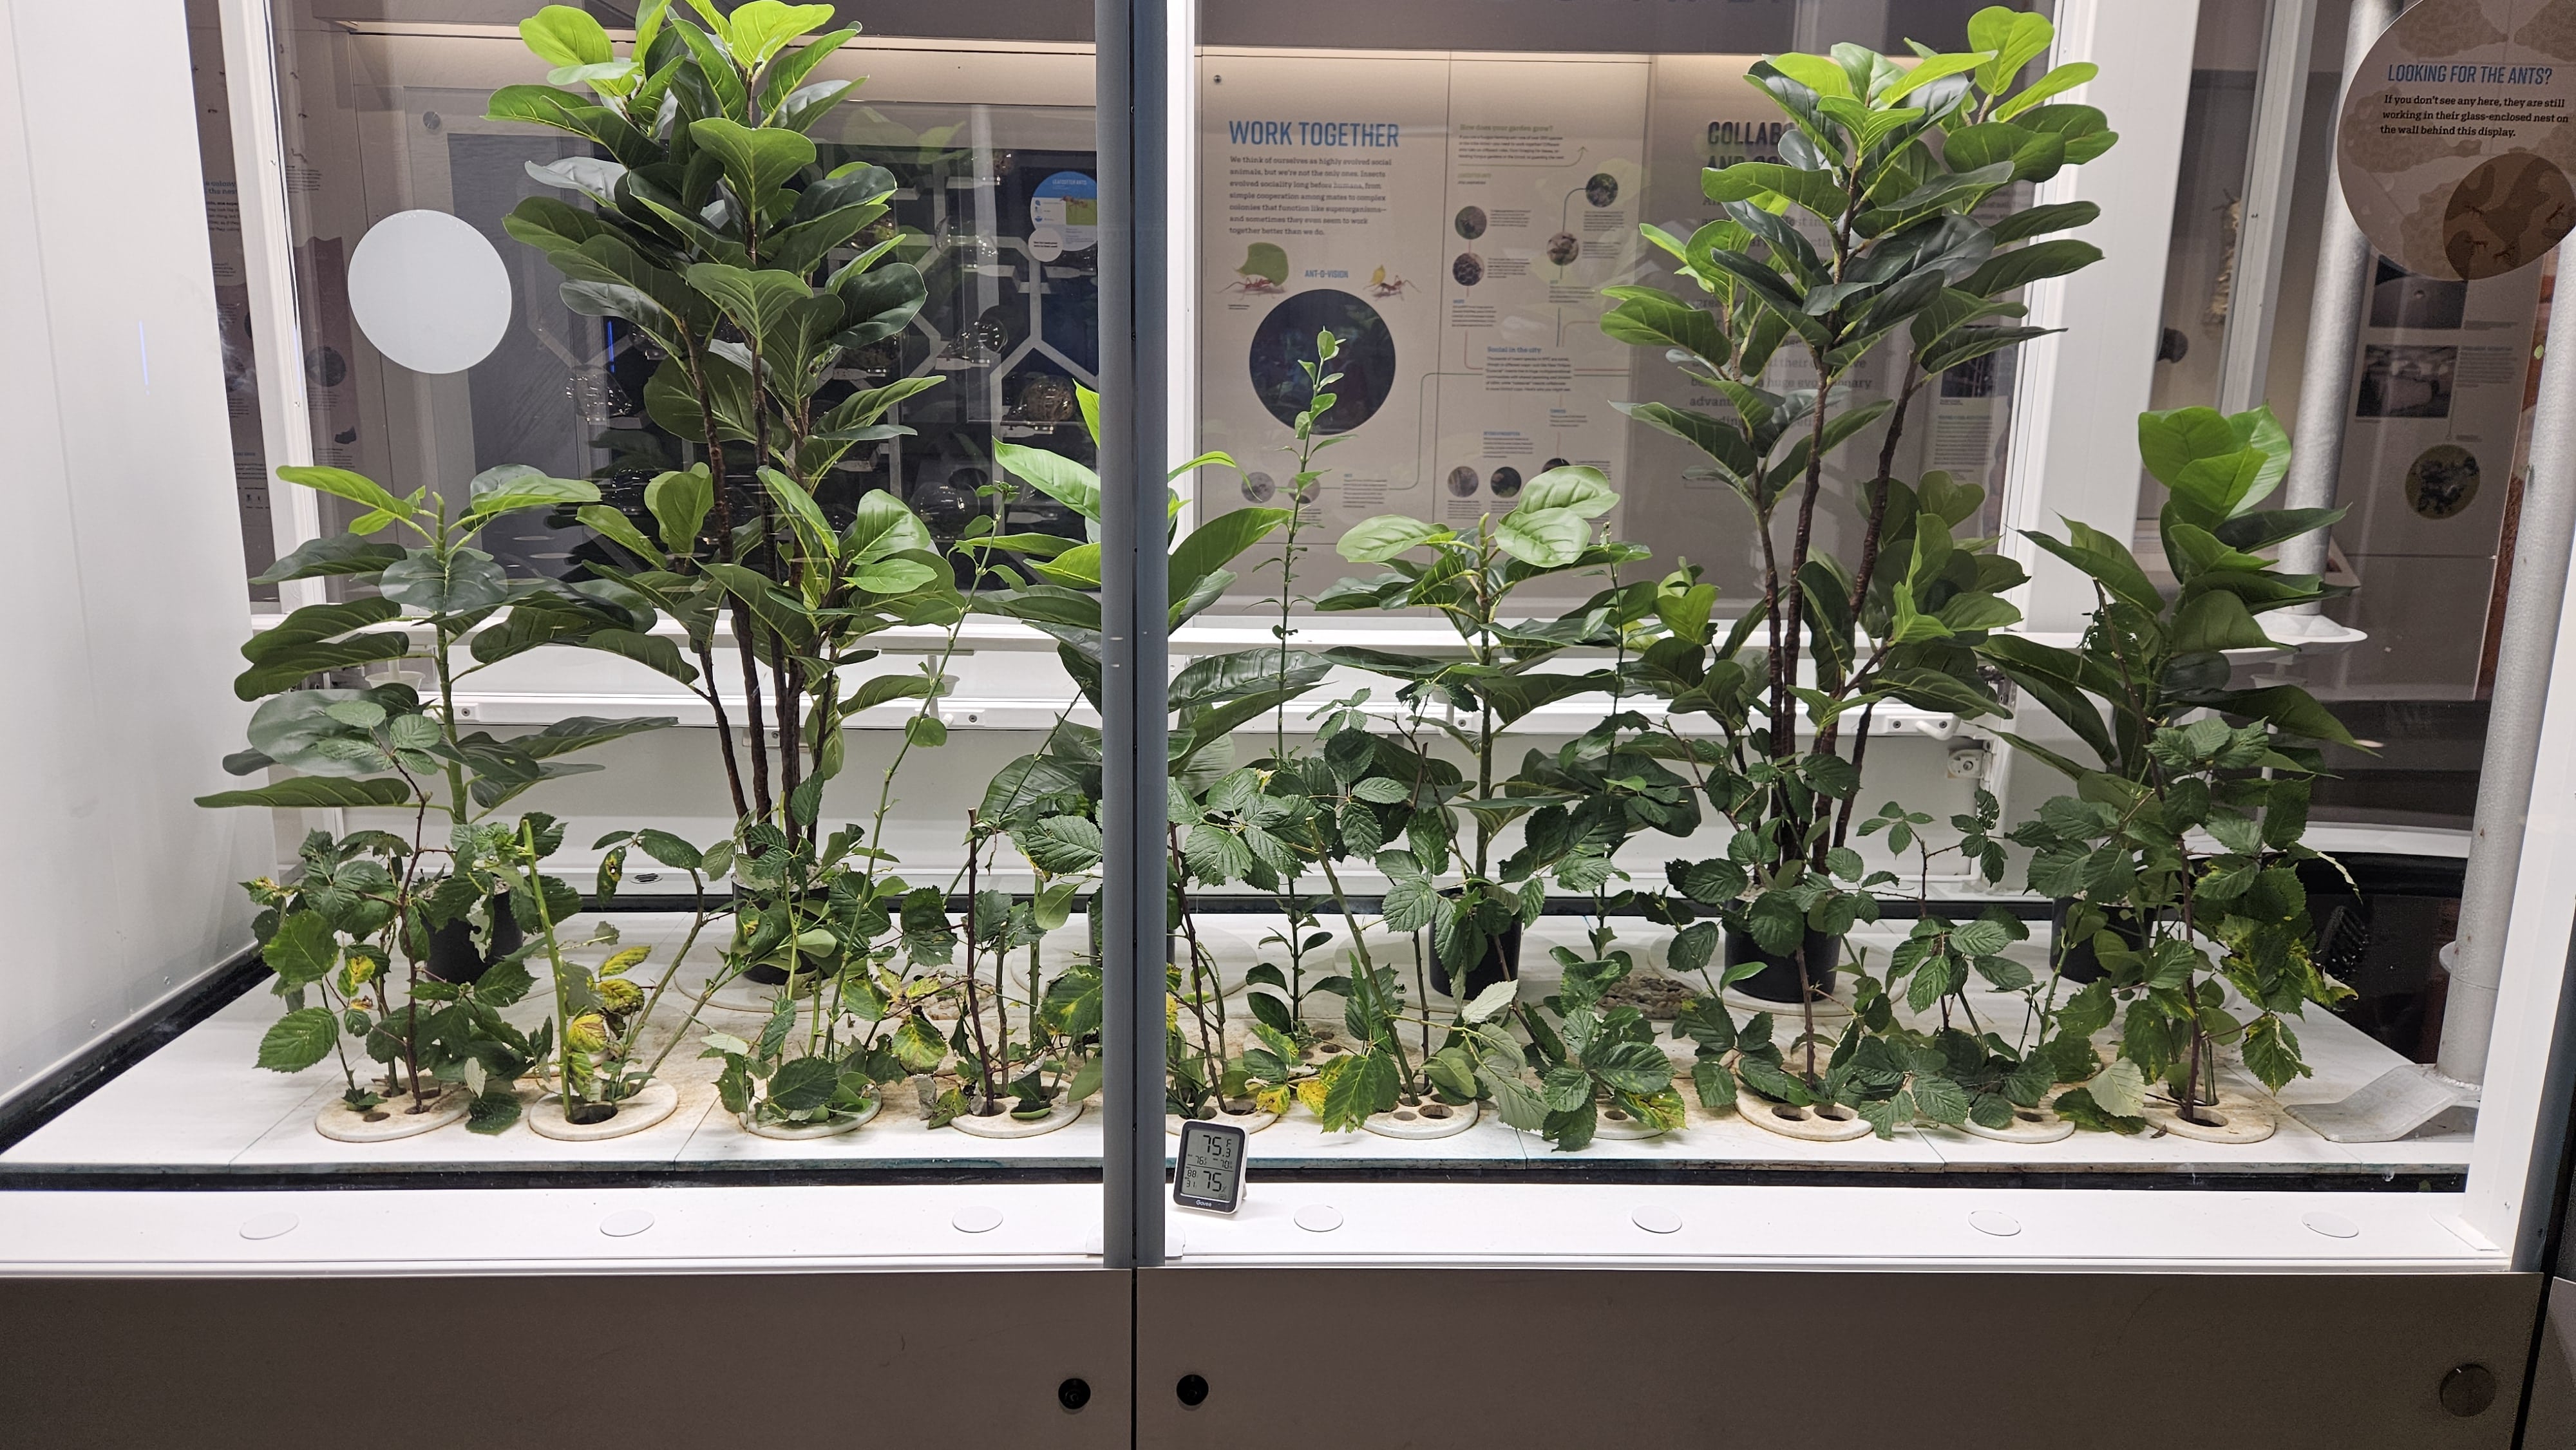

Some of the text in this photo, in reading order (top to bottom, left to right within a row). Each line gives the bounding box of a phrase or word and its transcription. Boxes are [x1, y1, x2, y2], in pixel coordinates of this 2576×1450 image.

[2388, 64, 2552, 84] LOOKING FOR THE ANTS?
[2384, 95, 2394, 104] If
[2394, 97, 2411, 106] you
[2458, 99, 2477, 107] any
[2477, 97, 2501, 107] here,
[2504, 97, 2525, 108] they
[2544, 99, 2564, 108] still
[2383, 110, 2421, 121] working
[2423, 111, 2433, 120] in
[2436, 111, 2459, 120] their
[2461, 112, 2532, 122] glass-enclosed
[1229, 120, 1399, 147] WORK TOGETHER
[2380, 126, 2396, 134] the
[2421, 126, 2455, 135] behind
[2458, 126, 2476, 135] this
[2478, 127, 2515, 138] display.
